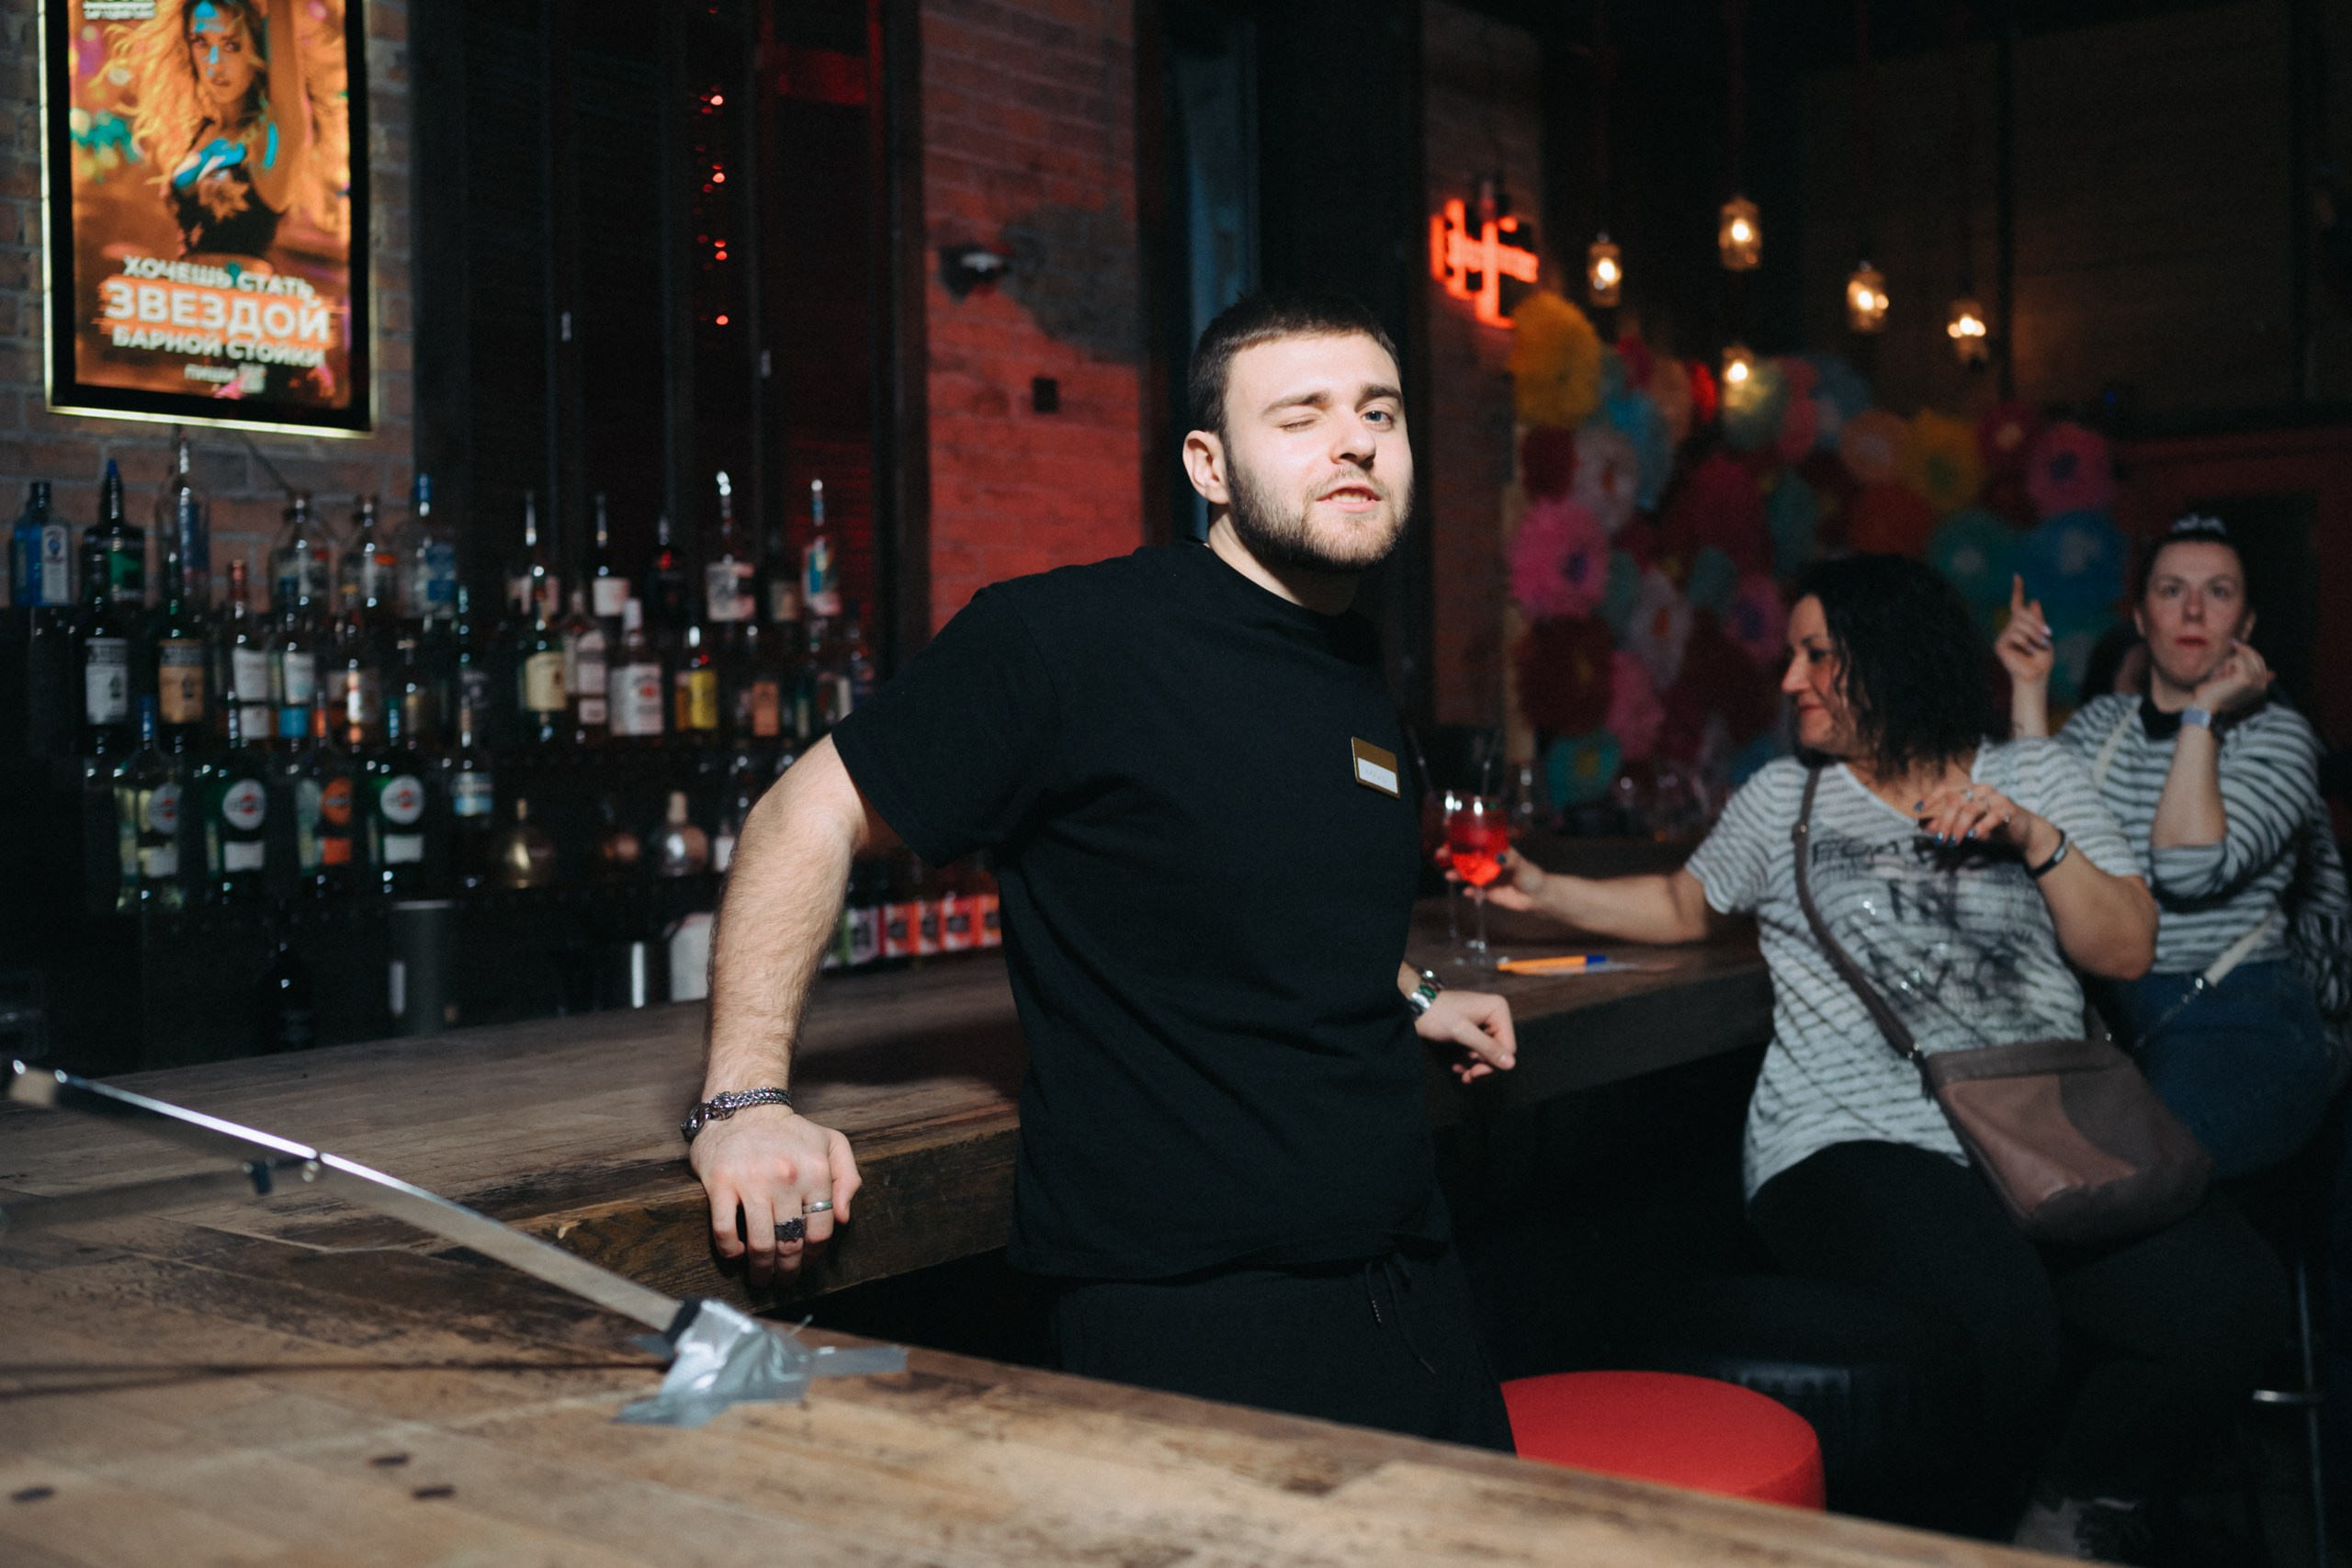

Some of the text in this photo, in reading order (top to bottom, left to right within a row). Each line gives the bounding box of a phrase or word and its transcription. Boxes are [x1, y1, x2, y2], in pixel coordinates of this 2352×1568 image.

[123, 254, 315, 301] ХОЧЕШЬ СТАТЬ
[104, 281, 330, 343] ЗВЕЗДОЙ
[112, 325, 325, 367] БАРНОЙ СТОЙКИ
